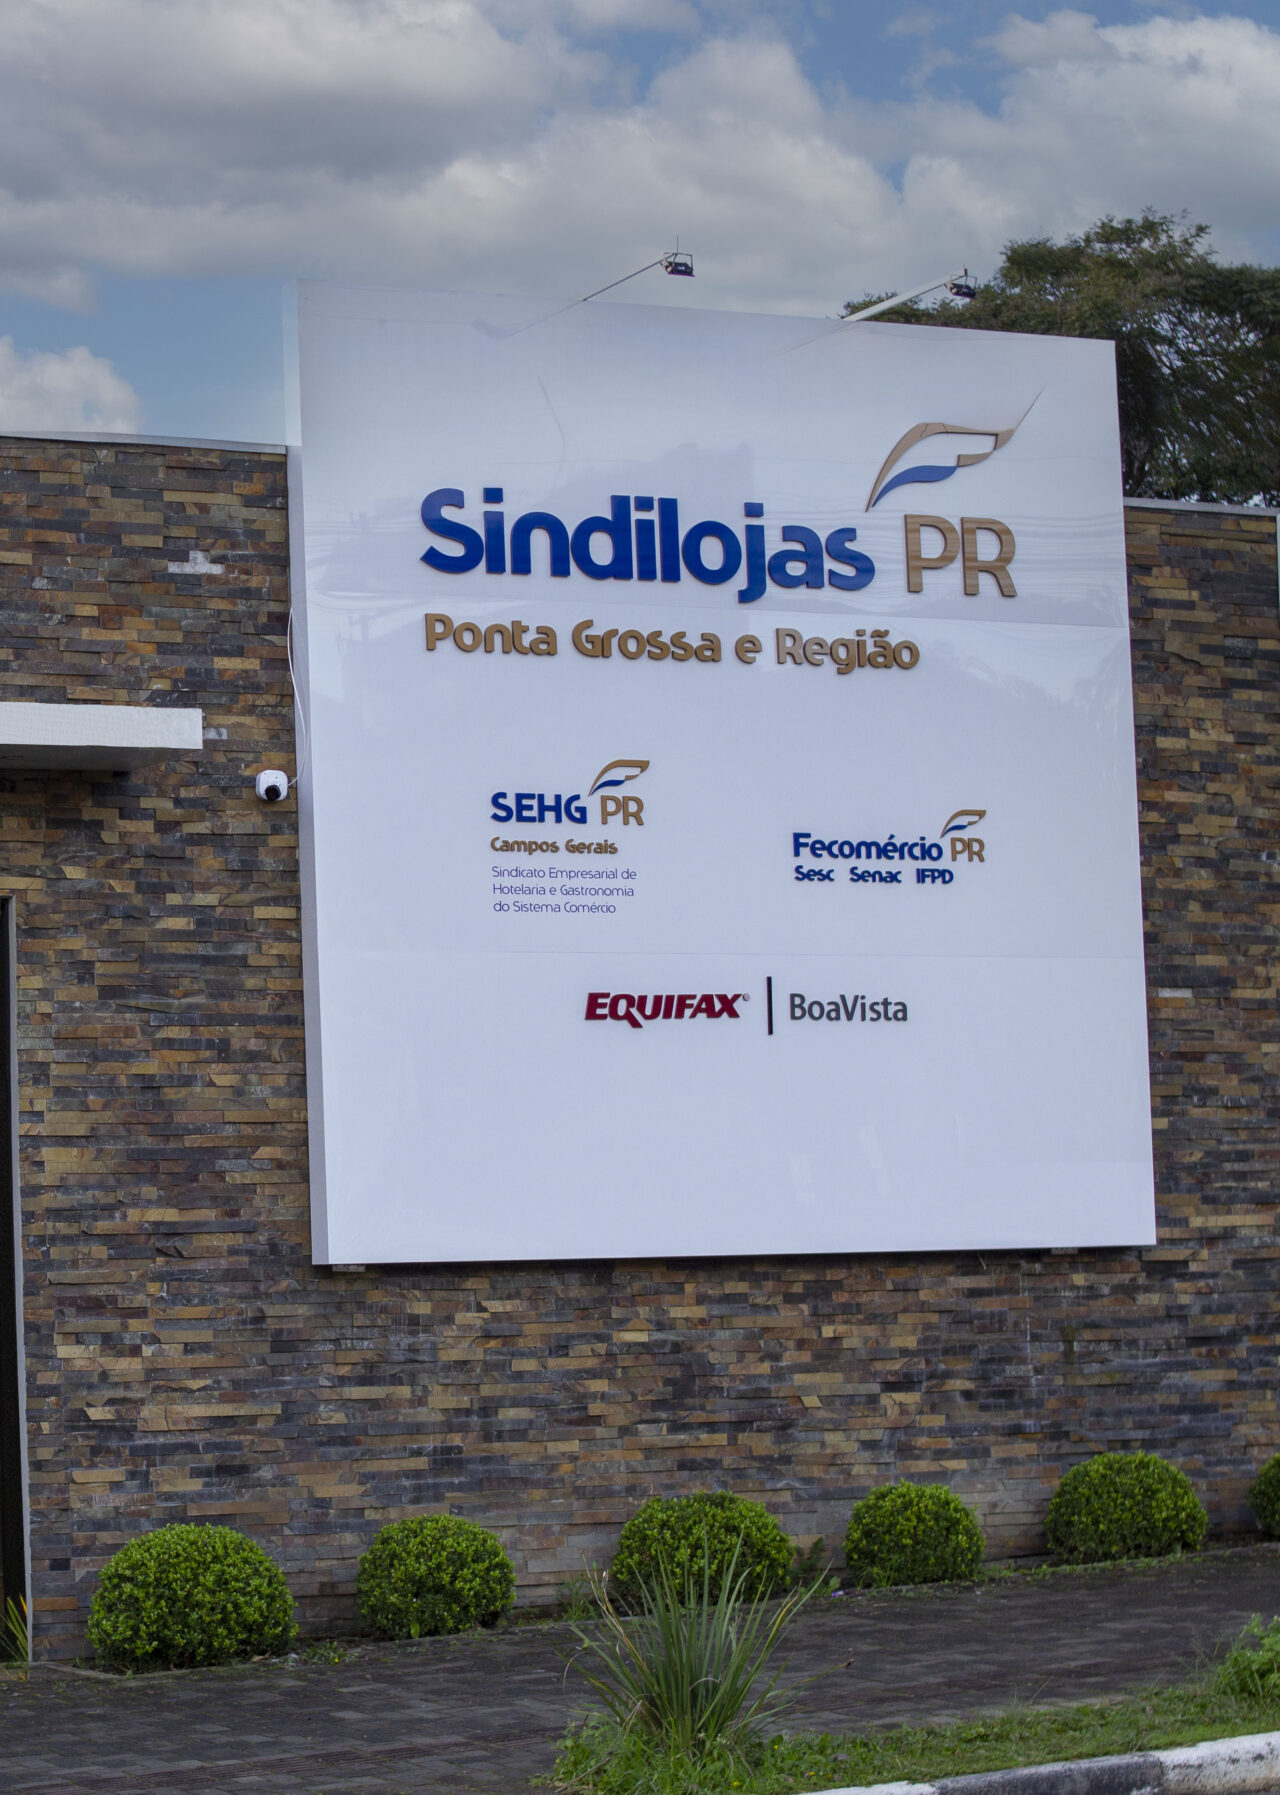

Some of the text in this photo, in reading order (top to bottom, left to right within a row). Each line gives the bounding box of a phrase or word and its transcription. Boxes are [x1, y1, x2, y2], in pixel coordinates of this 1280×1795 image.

[419, 487, 1018, 603] Sindilojas PR
[424, 613, 920, 675] Ponta Grossa e Região
[490, 792, 645, 826] SEHG PR
[490, 836, 618, 855] Campos Gerais
[792, 832, 985, 862] Fecomércio PR
[491, 866, 637, 880] Sindicato Empresarial de
[794, 865, 954, 884] Sesc Senac IFPD
[493, 883, 634, 896] Hotelaria e Gastronomia
[493, 901, 616, 913] do Sistema Comércio
[584, 992, 744, 1028] EQUIFAX
[789, 992, 908, 1022] BoaVista
